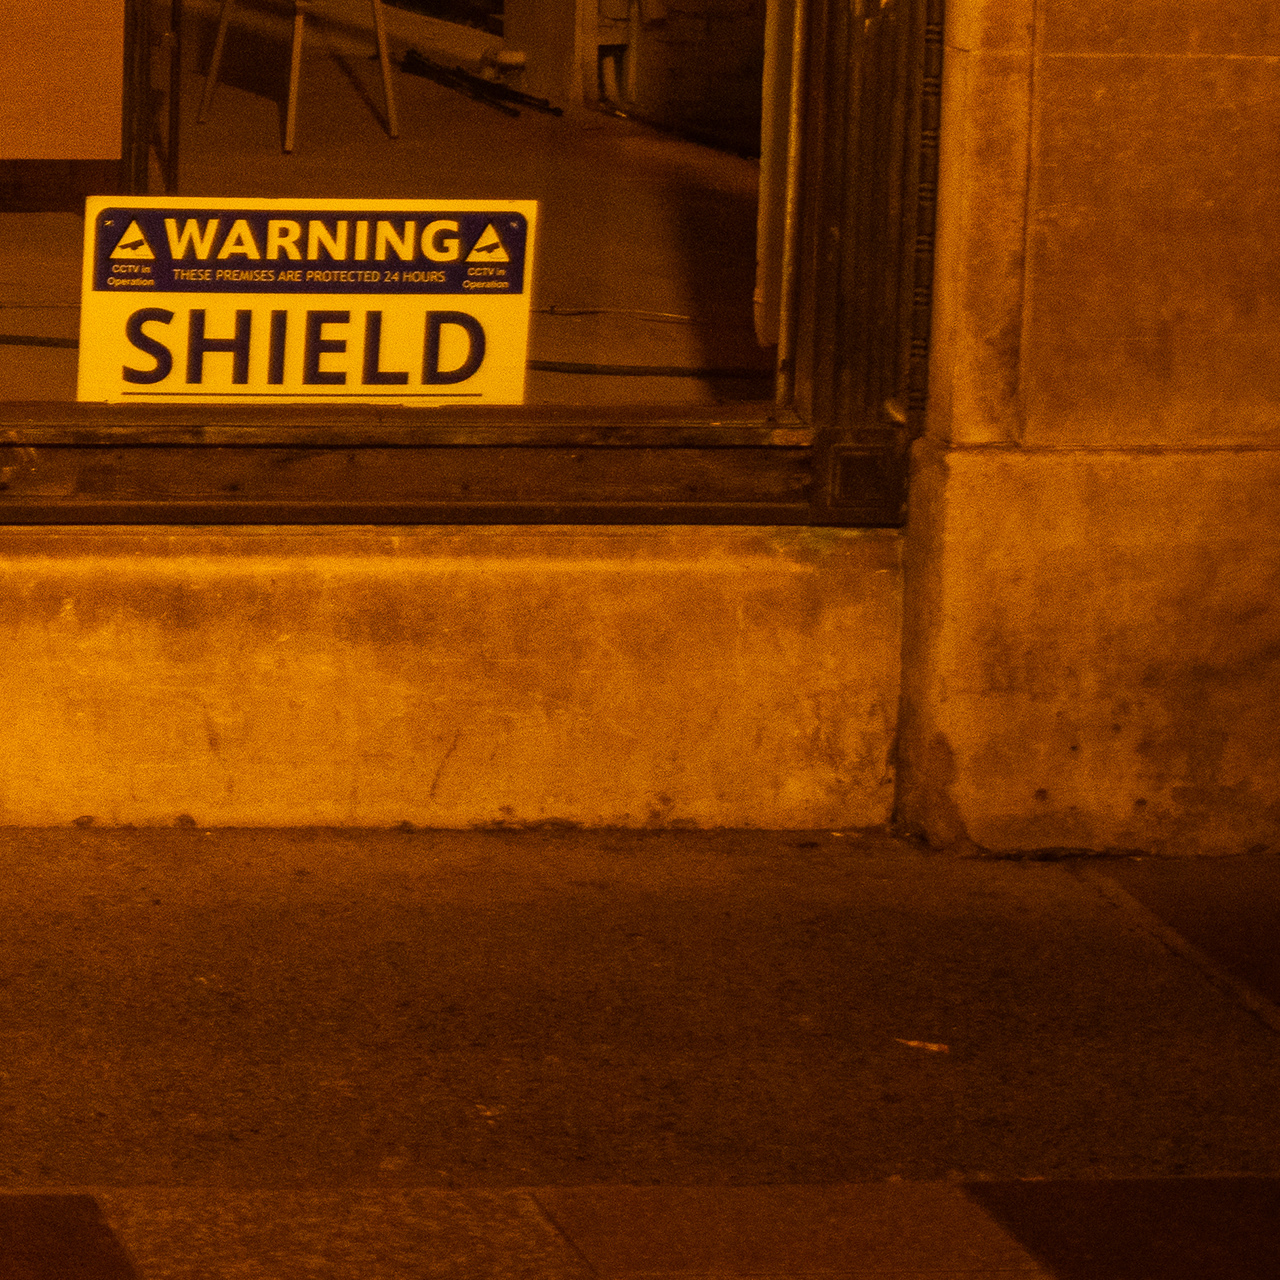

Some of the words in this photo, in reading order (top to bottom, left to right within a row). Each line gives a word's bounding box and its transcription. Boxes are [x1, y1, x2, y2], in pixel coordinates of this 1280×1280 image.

[164, 218, 462, 262] WARNING
[112, 264, 139, 274] CCTV
[140, 265, 151, 274] in
[467, 267, 494, 276] CCTV
[496, 268, 506, 277] in
[106, 276, 155, 287] Operation
[172, 269, 212, 281] THESE
[216, 269, 274, 282] PREMISES
[278, 270, 301, 282] ARE
[306, 270, 380, 282] PROTECTED
[383, 271, 399, 283] 24
[402, 271, 446, 283] HOURS
[462, 279, 509, 290] Operation
[122, 307, 486, 385] SHIELD
